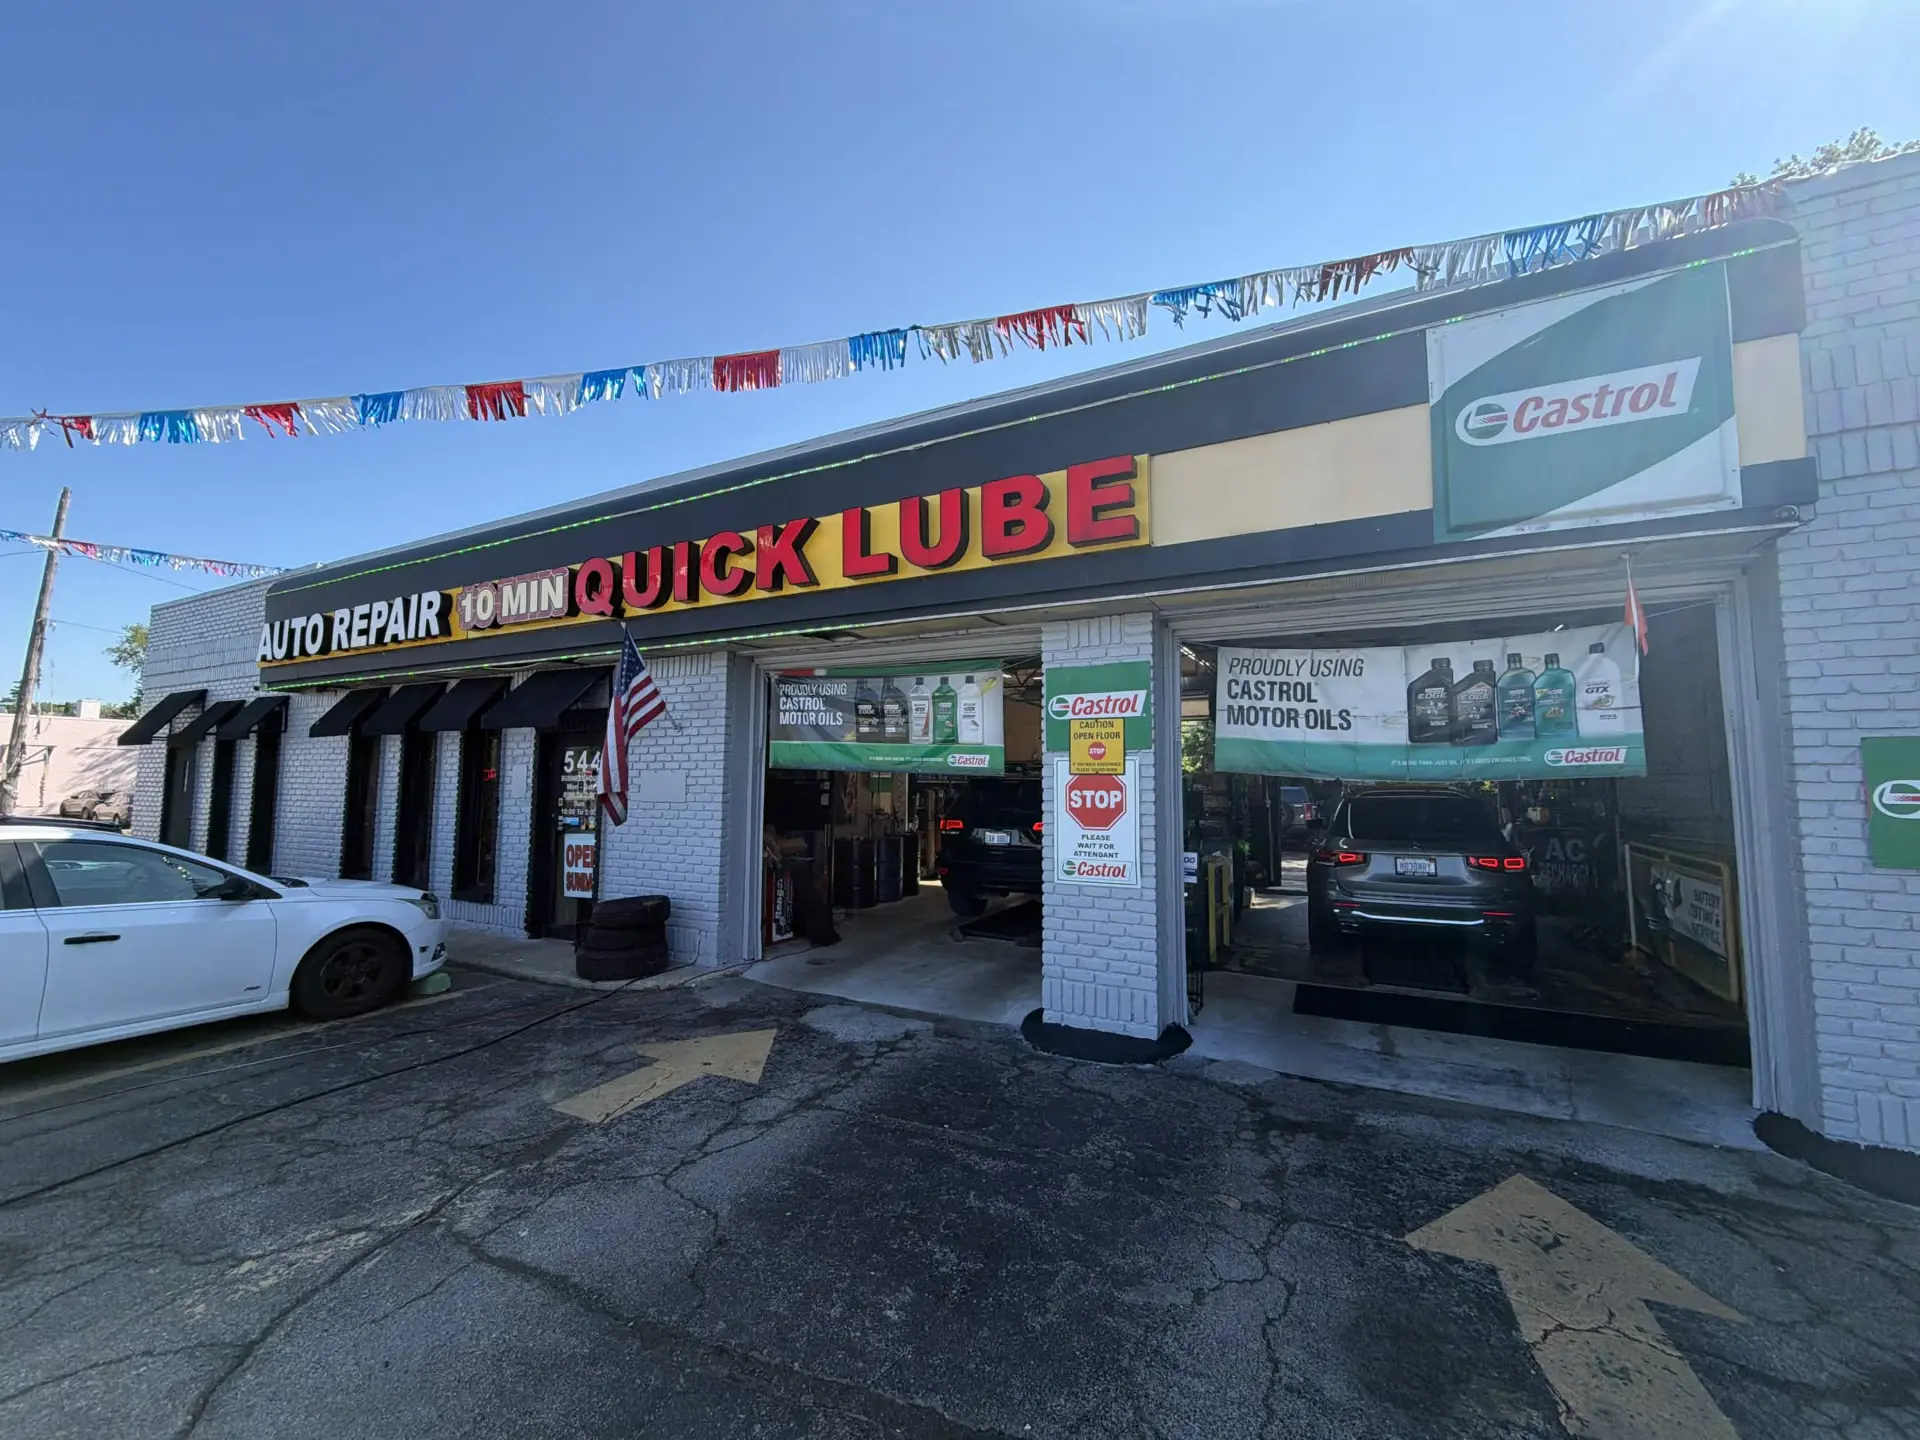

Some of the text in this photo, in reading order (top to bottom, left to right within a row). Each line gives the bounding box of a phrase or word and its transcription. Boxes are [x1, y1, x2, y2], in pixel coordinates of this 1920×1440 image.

[1513, 371, 1678, 433] Castrol
[255, 454, 1142, 662] AUTO REPAIR 10 MIN QUICK LUBE
[1228, 657, 1365, 678] PROUDLY USING
[779, 683, 847, 696] PROUDLY USING
[1227, 679, 1318, 703] CASTROL
[1585, 685, 1610, 695] GTX
[779, 697, 826, 711] CASTROL
[1071, 694, 1139, 716] Castrol
[779, 711, 843, 726] MOTOR OILS
[1079, 720, 1115, 729] CAUTION
[1226, 705, 1352, 731] MOTOR OILS
[1073, 731, 1121, 740] OPEN FLOOR
[1088, 747, 1106, 755] STOP
[1564, 748, 1622, 764] Castrol
[956, 754, 987, 767] Castrol
[1070, 789, 1122, 809] STOP
[1077, 842, 1096, 850] WAIT
[1545, 837, 1587, 863] AC
[1073, 851, 1119, 859] ATTENDANT
[1077, 861, 1127, 878] Castrol
